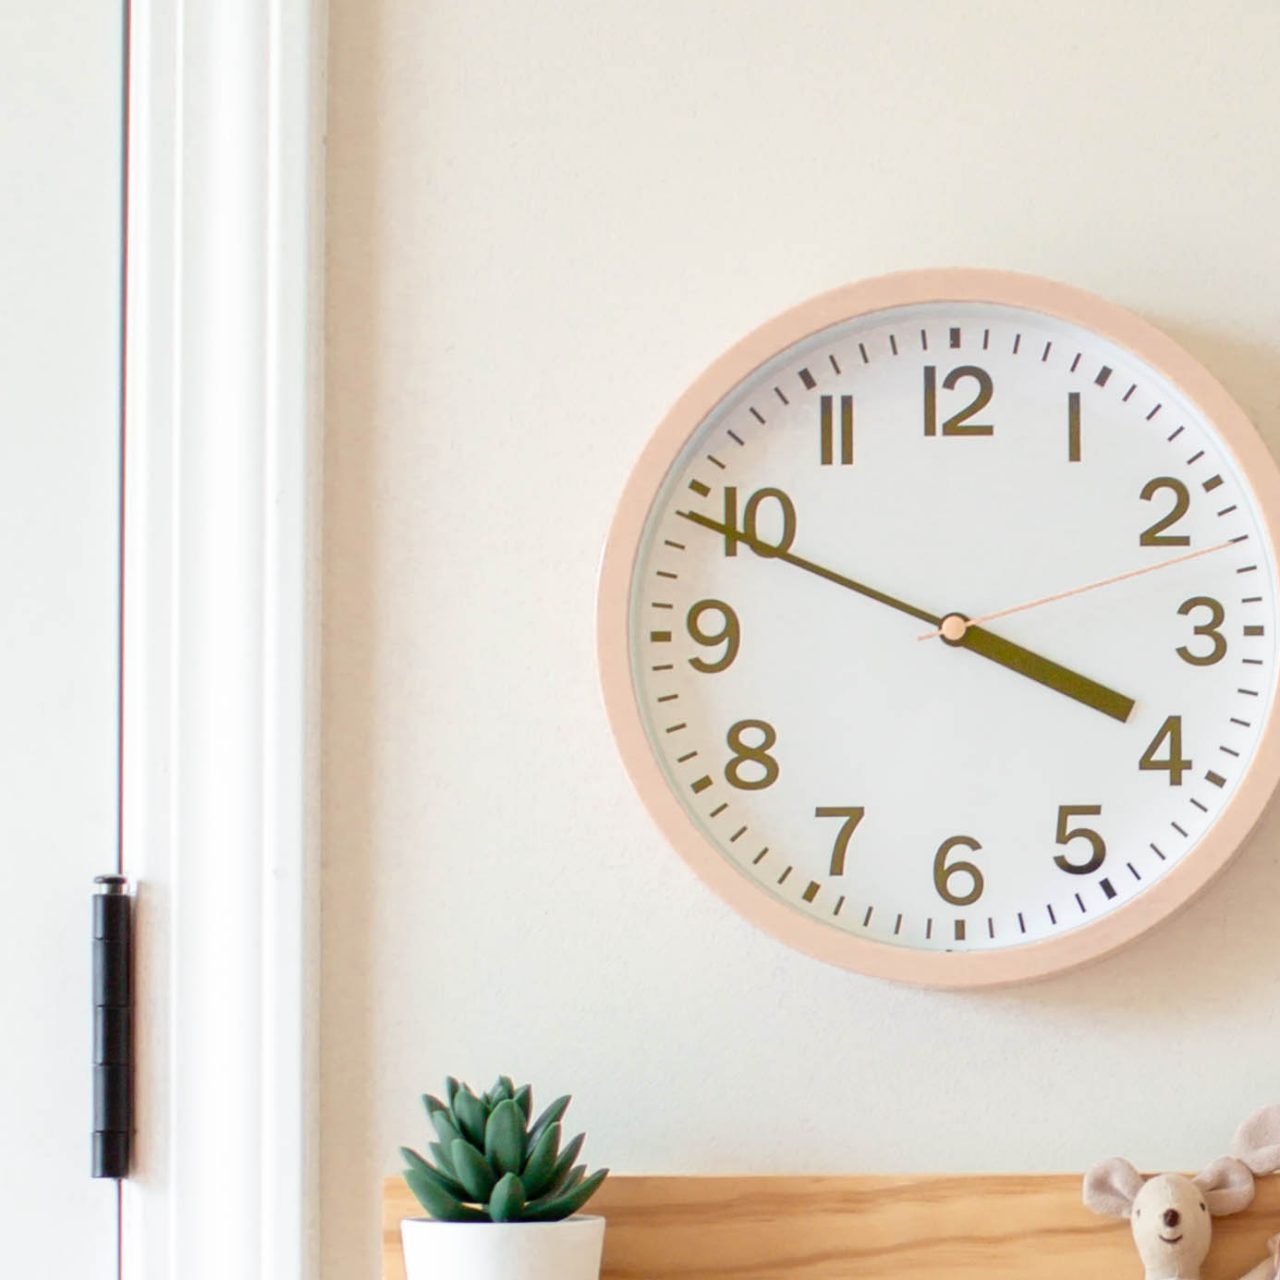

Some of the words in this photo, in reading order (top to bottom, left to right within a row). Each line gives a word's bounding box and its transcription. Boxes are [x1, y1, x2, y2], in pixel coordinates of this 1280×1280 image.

[820, 395, 853, 465] 11
[924, 366, 993, 436] 12
[1068, 392, 1080, 462] 1
[724, 486, 796, 558] 10
[1139, 477, 1190, 546] 2
[686, 599, 740, 673] 9
[1175, 596, 1227, 666] 3
[724, 720, 779, 790] 8
[1138, 715, 1192, 786] 4
[815, 807, 864, 876] 7
[933, 836, 984, 906] 6
[1053, 805, 1106, 875] 5
